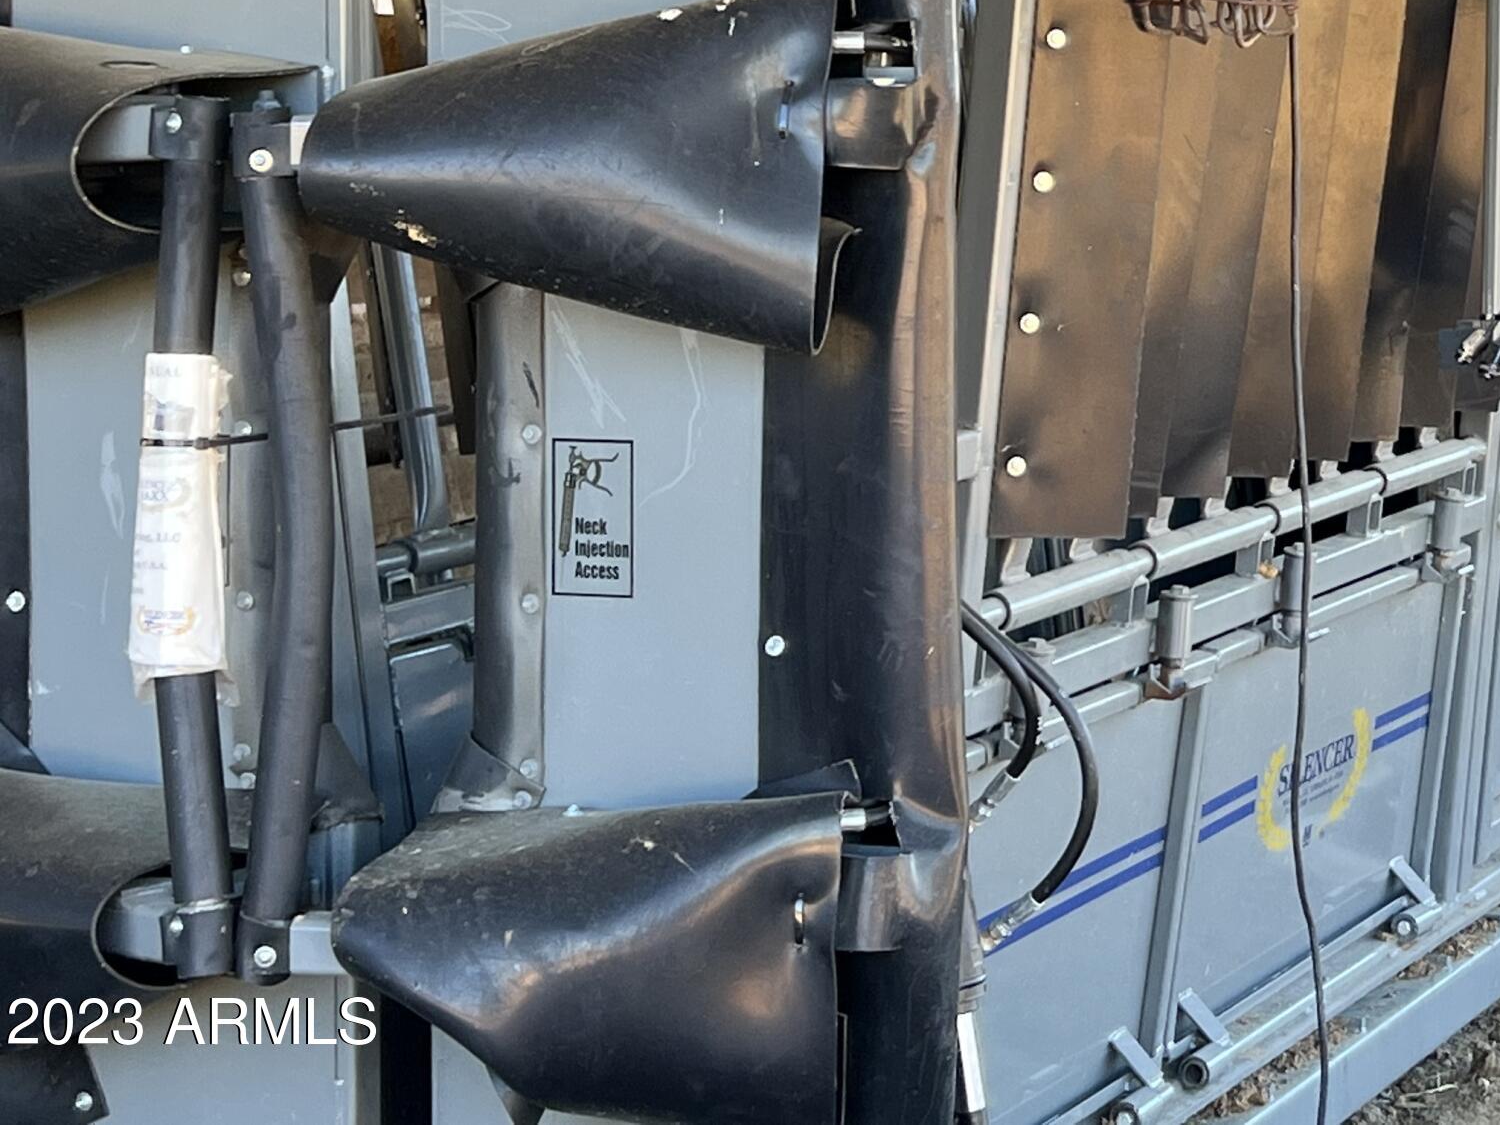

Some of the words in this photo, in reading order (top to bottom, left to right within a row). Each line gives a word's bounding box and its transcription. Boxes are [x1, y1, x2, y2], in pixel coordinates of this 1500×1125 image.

[575, 517, 607, 535] Neck
[575, 540, 629, 558] Injection
[575, 561, 619, 580] Access
[1278, 734, 1355, 796] SENCER
